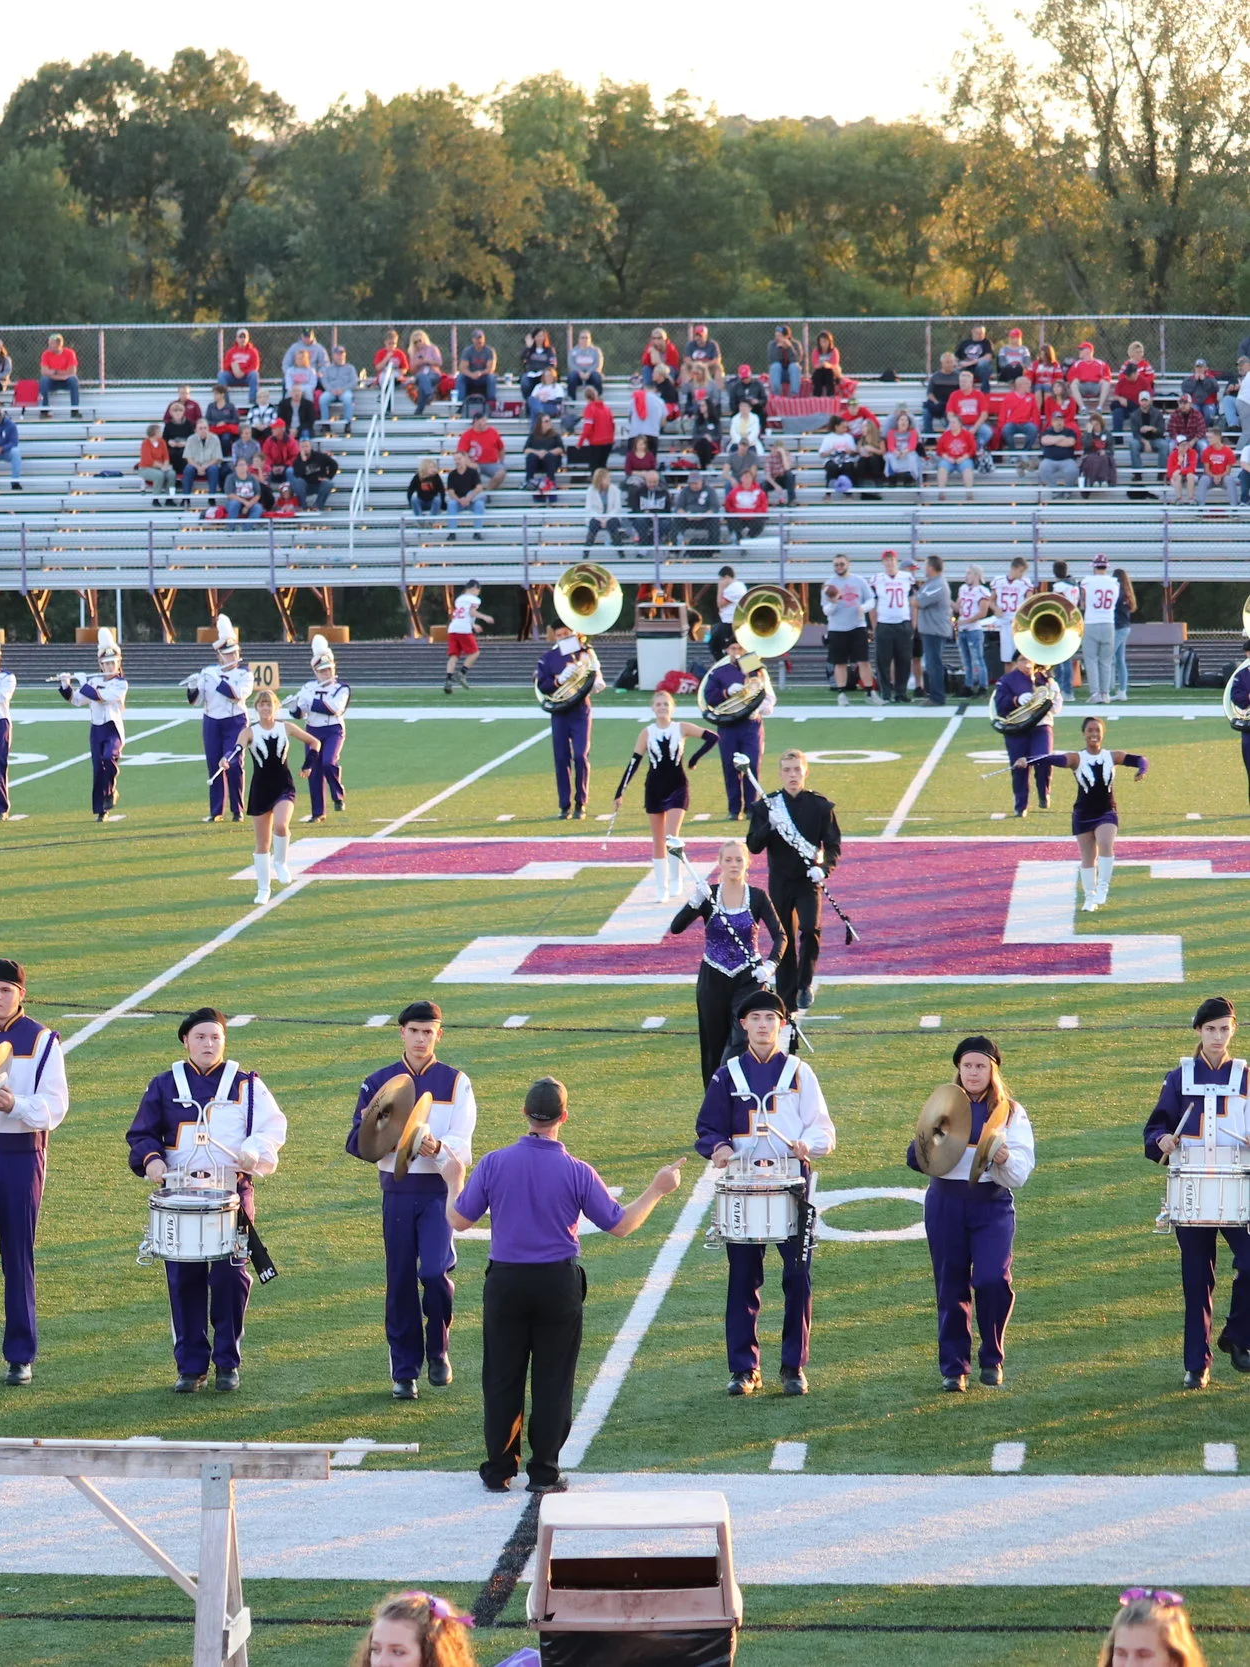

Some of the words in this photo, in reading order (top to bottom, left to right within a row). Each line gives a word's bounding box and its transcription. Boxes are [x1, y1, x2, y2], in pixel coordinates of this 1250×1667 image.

[885, 587, 904, 609] 70
[1000, 592, 1019, 613] 53
[1092, 589, 1114, 610] 36
[253, 665, 273, 687] 40
[760, 1159, 768, 1167] M
[1185, 1184, 1194, 1213] MAPEX
[166, 1218, 174, 1247] MAPEX
[260, 1267, 276, 1283] VIC
